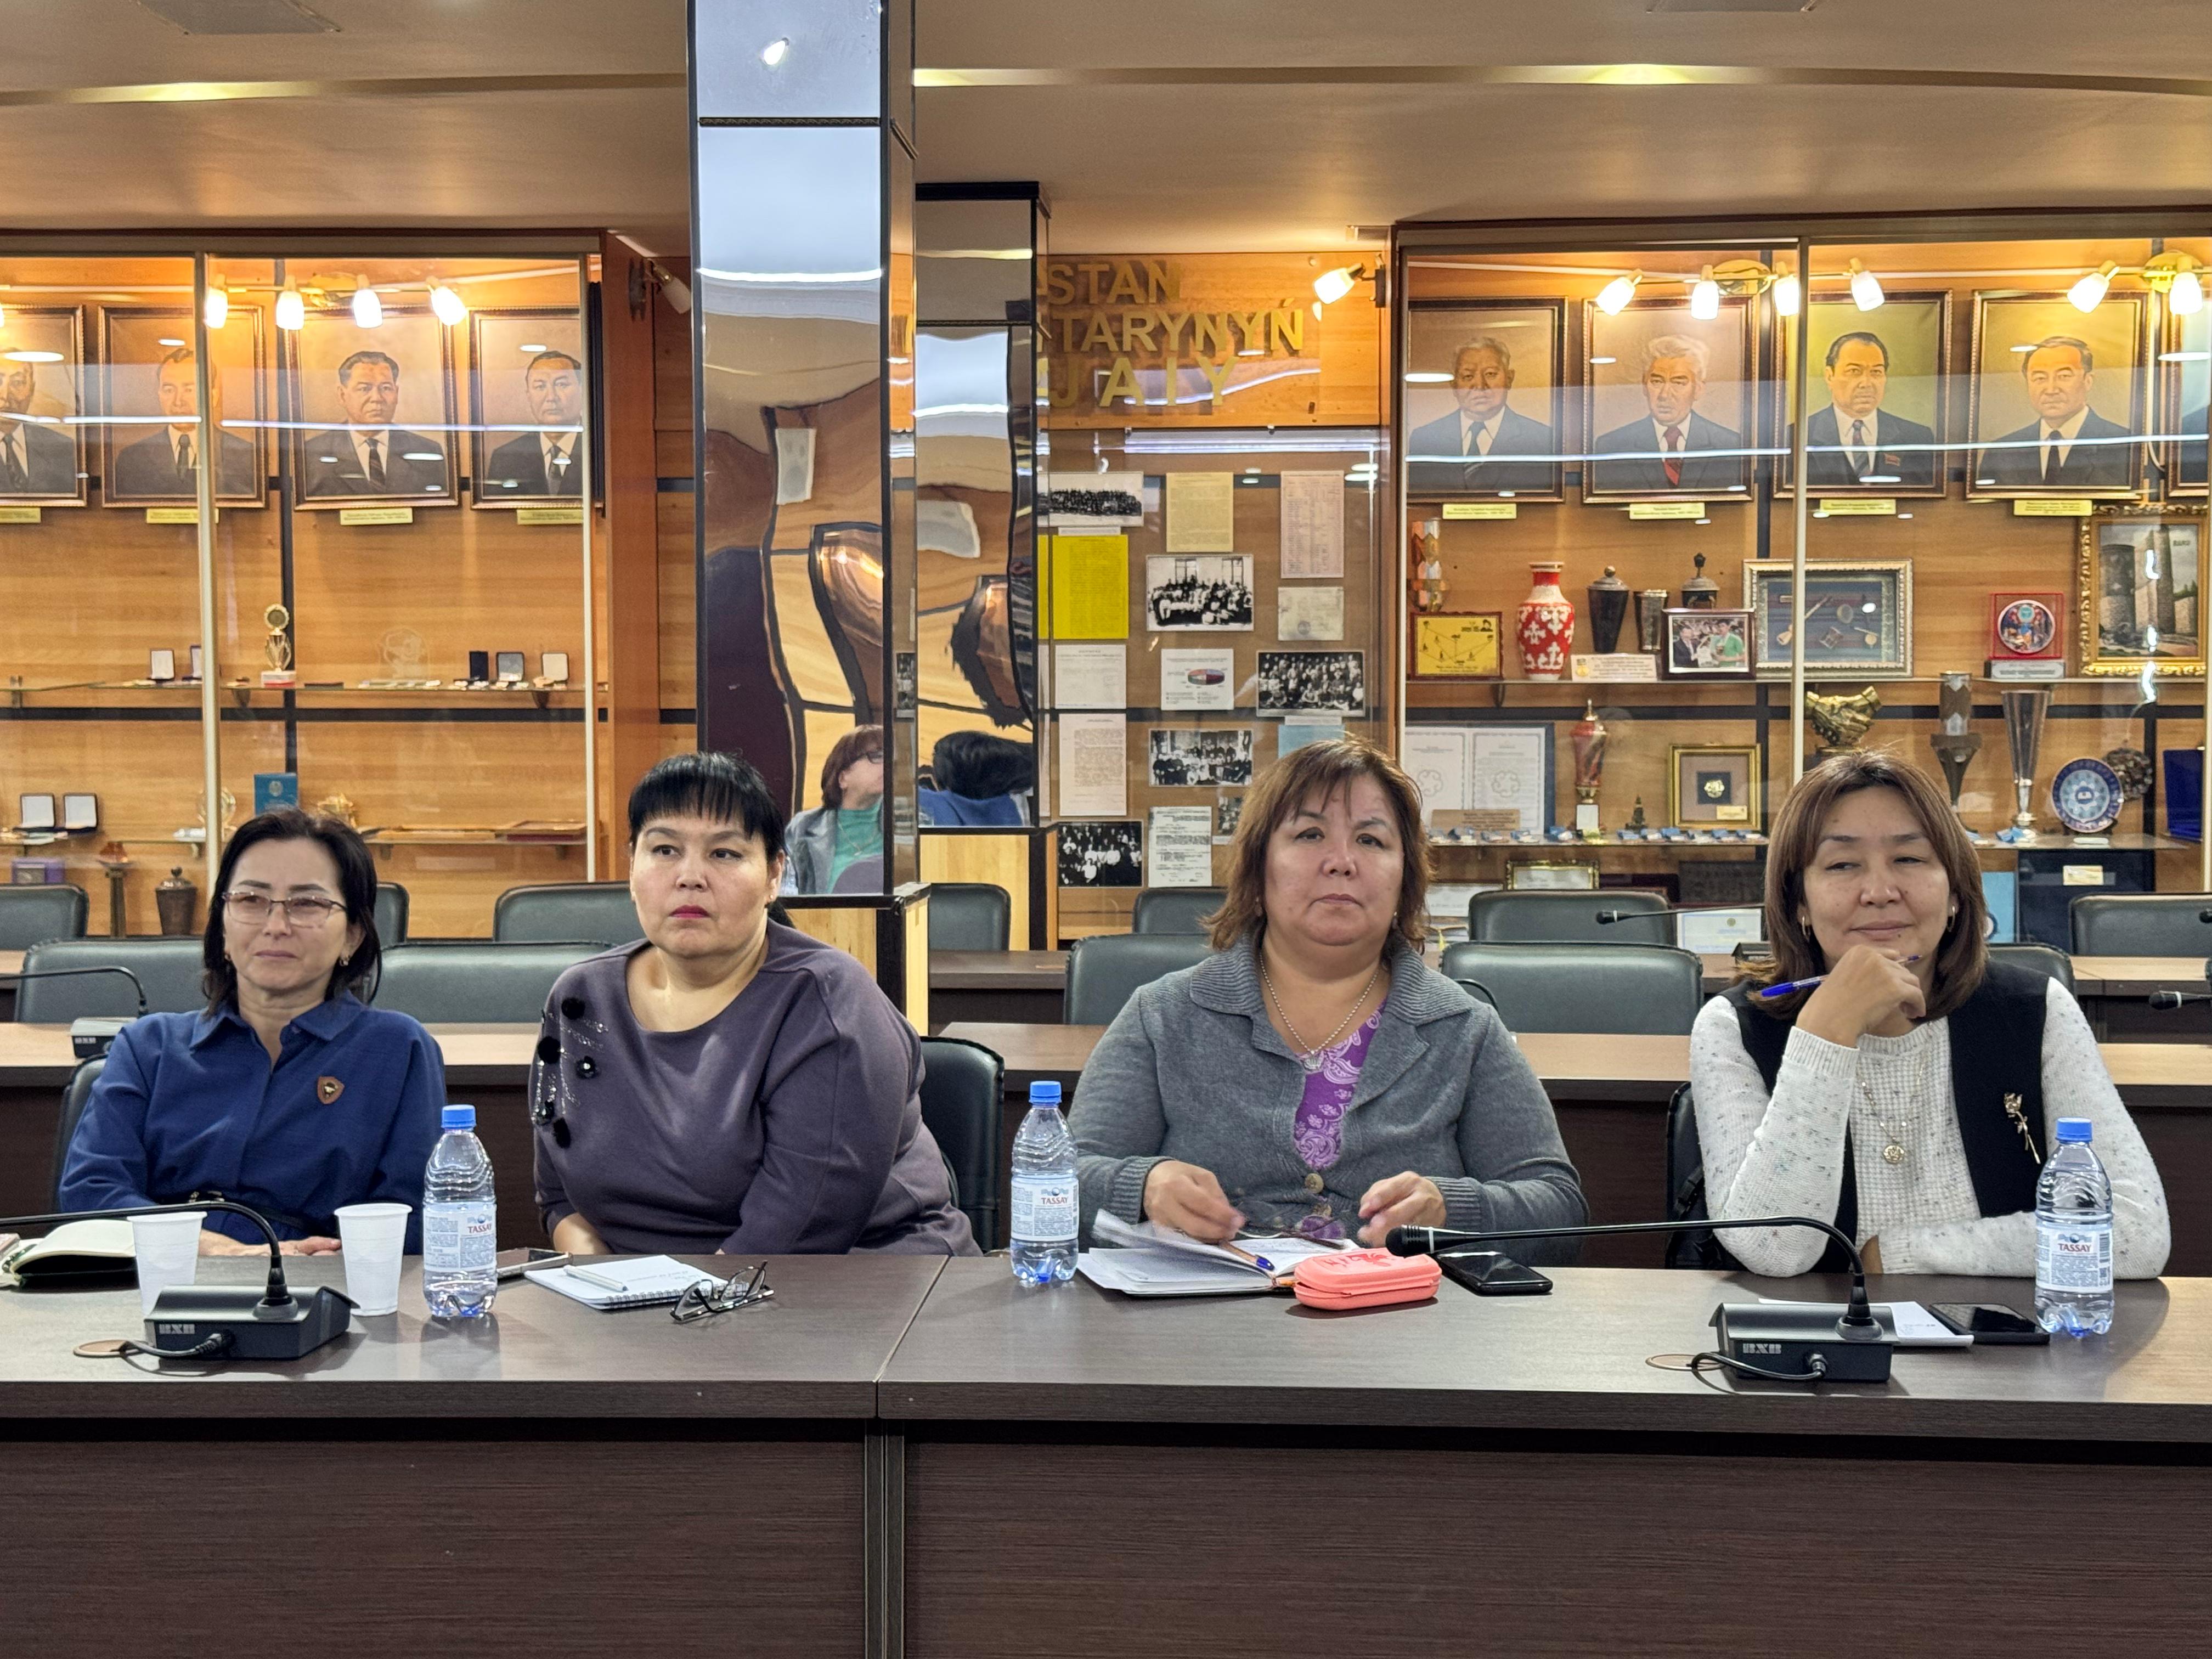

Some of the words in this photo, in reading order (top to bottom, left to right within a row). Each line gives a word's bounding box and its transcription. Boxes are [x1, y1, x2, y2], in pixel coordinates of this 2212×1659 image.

[1048, 262, 1181, 305] STAN
[1052, 298, 1304, 352] TARYNYŃ
[1050, 356, 1240, 408] JAIY
[1041, 1197, 1068, 1205] TASSAY
[2057, 1243, 2091, 1252] TASSAY
[1742, 1343, 1782, 1354] BXB
